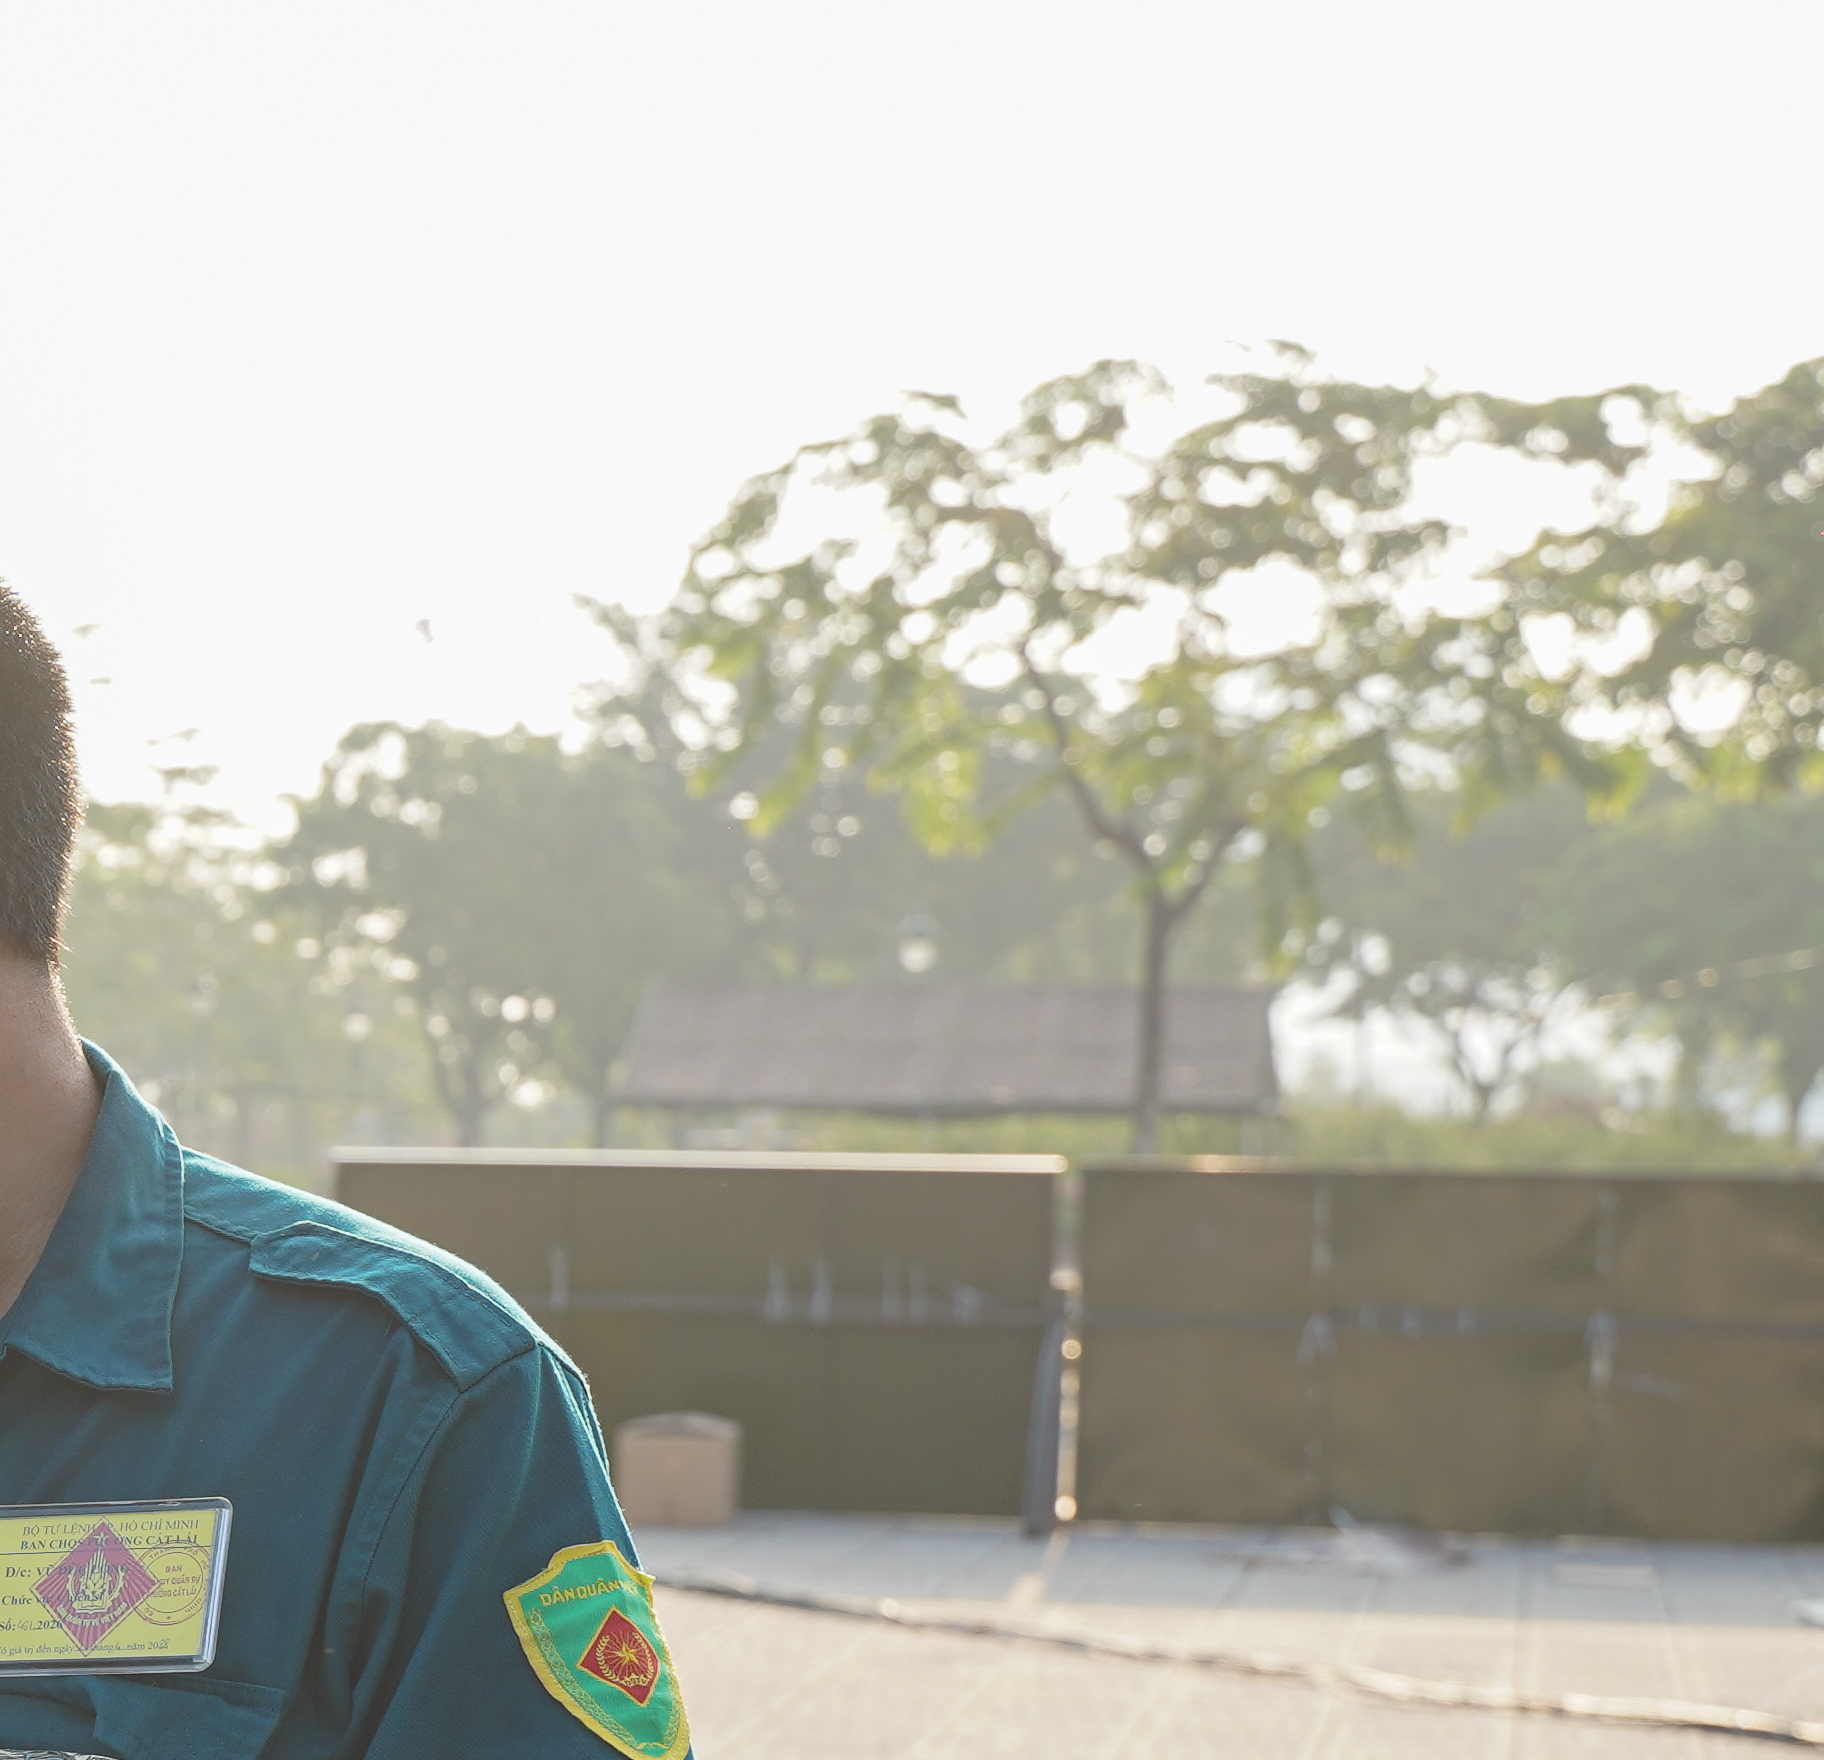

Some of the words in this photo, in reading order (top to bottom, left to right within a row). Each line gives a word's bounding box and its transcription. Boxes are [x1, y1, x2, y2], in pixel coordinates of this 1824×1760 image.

[22, 1524, 40, 1537] BỘ
[42, 1523, 61, 1535] TƯ
[120, 1519, 138, 1532] HỒ
[140, 1518, 162, 1531] CHÍ
[165, 1519, 199, 1530] MINH
[20, 1540, 47, 1550] BAN
[146, 1532, 173, 1545] CÁT
[5, 1566, 31, 1578] Đ/c:
[1, 1594, 33, 1606] Chức
[539, 1585, 576, 1606] DÂN
[576, 1577, 621, 1600] QUÂN
